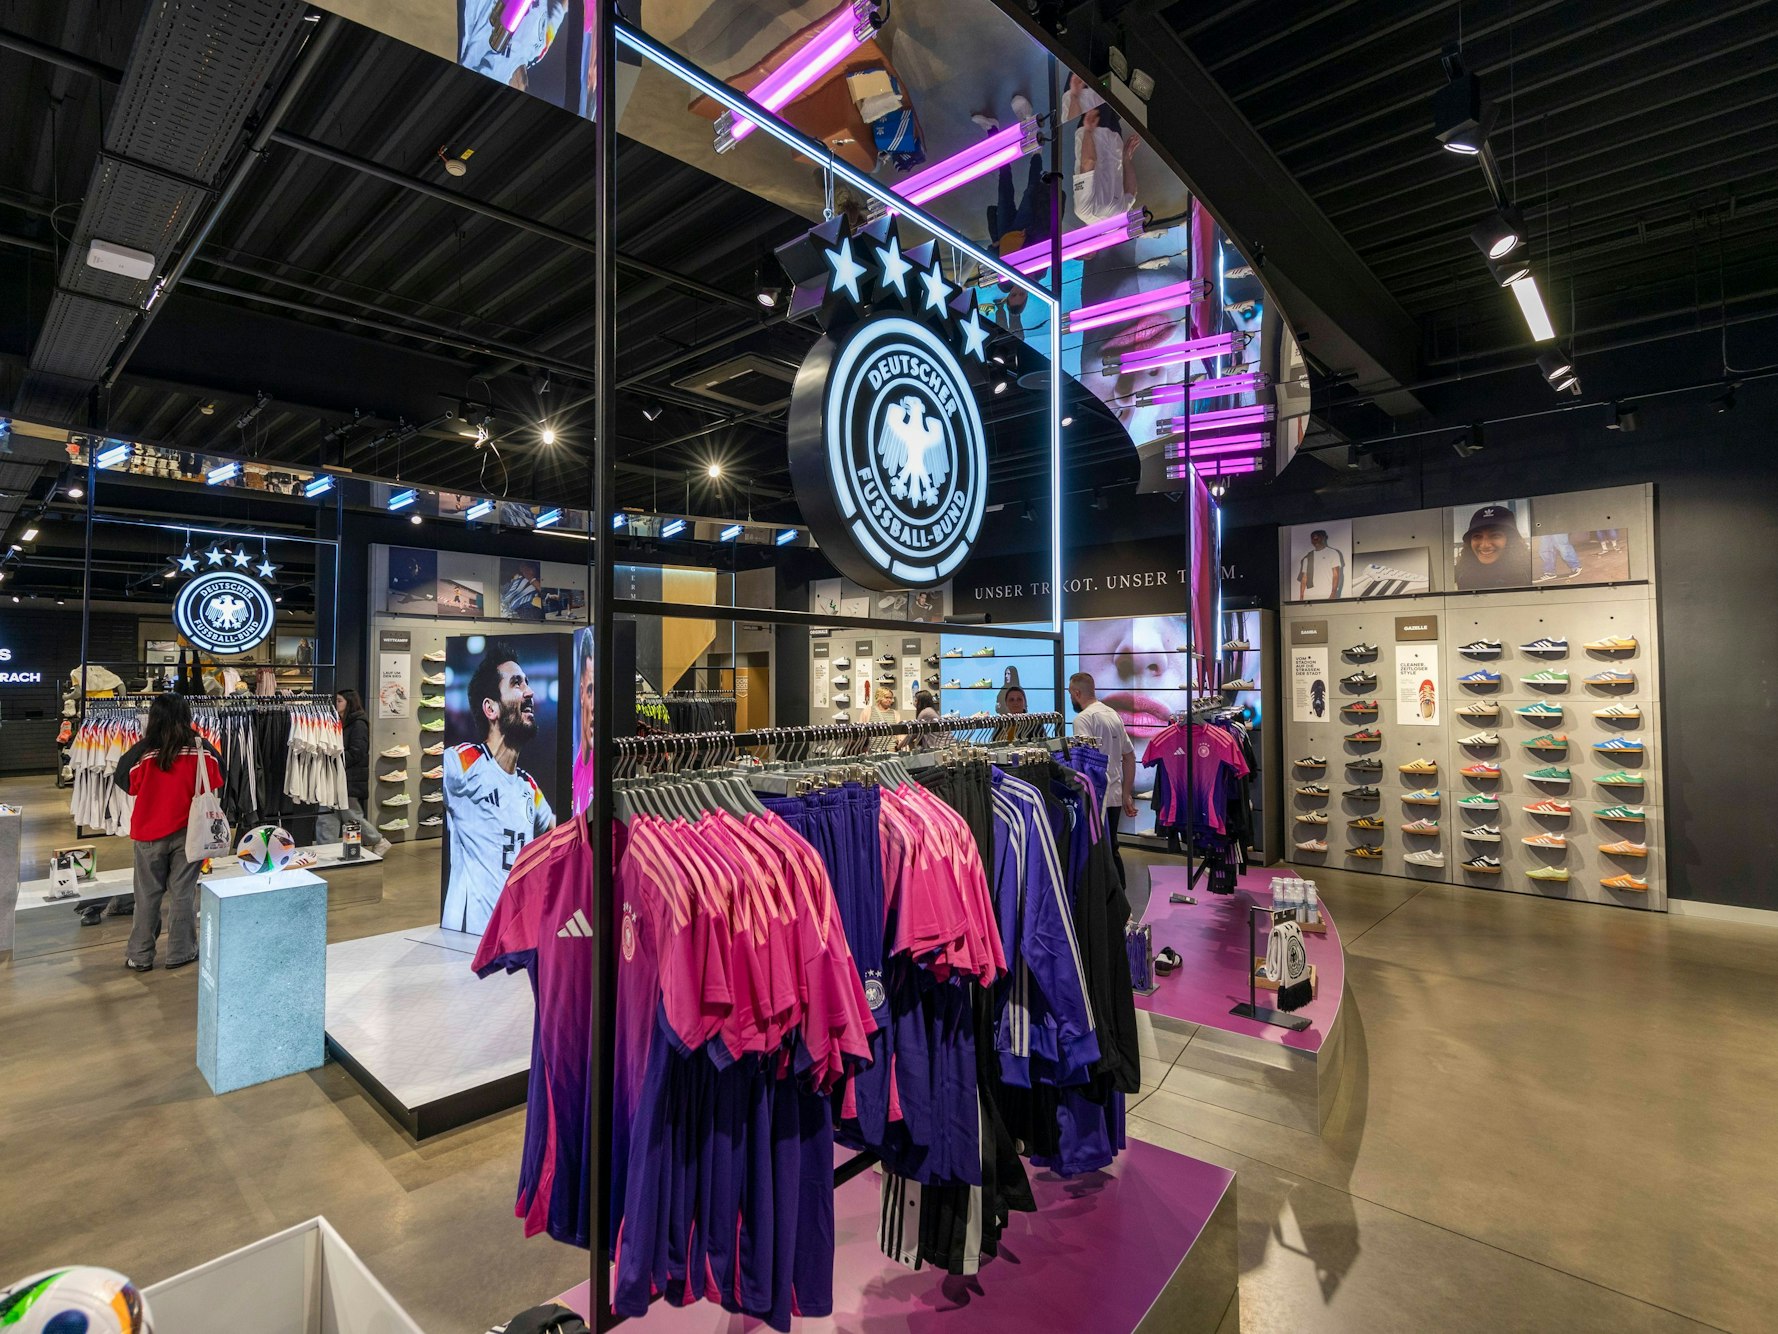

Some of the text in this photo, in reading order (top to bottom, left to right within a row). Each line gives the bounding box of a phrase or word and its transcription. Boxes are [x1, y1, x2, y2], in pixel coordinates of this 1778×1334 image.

[868, 355, 958, 418] DEUTSCHER
[857, 466, 966, 547] FUSSBALL-BUND
[199, 582, 254, 600] DEUTSCHER
[974, 584, 1023, 599] UNSER
[1030, 578, 1098, 596] TRKOT.
[1106, 571, 1168, 589] UNSER
[193, 619, 259, 642] FUSSBALL-BUND
